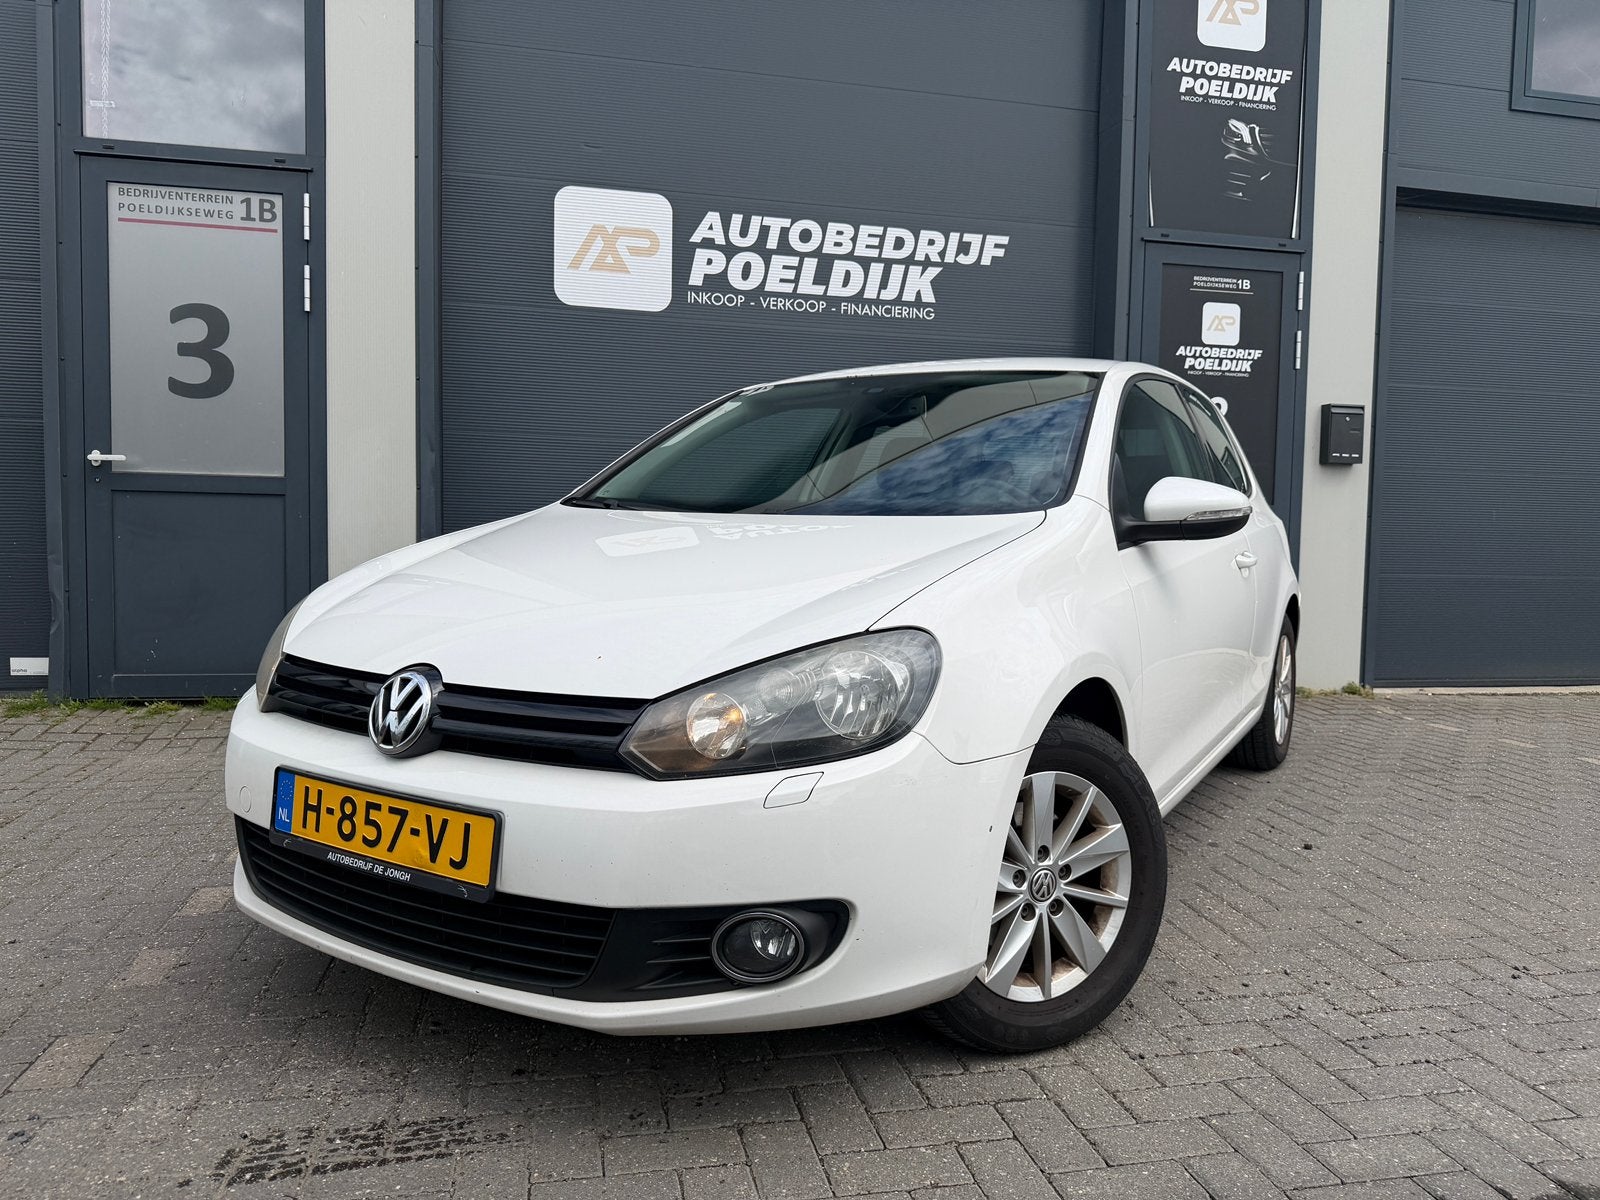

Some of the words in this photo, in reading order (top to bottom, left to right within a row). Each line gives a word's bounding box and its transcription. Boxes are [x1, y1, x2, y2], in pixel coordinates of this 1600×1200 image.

[1166, 57, 1293, 84] AUTOBEDRIJF
[1179, 76, 1279, 103] POELDIJK
[1180, 95, 1203, 103] INKOOP
[1208, 98, 1234, 106] VERKOOP
[118, 187, 234, 205] BEDRIJVENTERREIN
[239, 197, 278, 223] 1B
[118, 202, 234, 220] POELDIJKSEWEG
[688, 210, 1010, 266] AUTOBEDRIJF
[687, 247, 943, 303] POELDIJK
[1237, 279, 1251, 290] 1B
[687, 291, 745, 307] INKOOP
[760, 297, 827, 313] VERKOOP
[841, 302, 935, 320] FINANCIERING
[167, 302, 235, 399] 3
[1175, 346, 1263, 360] AUTOBEDRIJF
[1184, 357, 1253, 372] POELDIJK
[278, 807, 290, 823] NL
[302, 785, 471, 870] H-857-VJ
[327, 851, 373, 871] AUTOBEDRIJF
[373, 864, 384, 875] DE
[384, 867, 411, 881] JONGH
